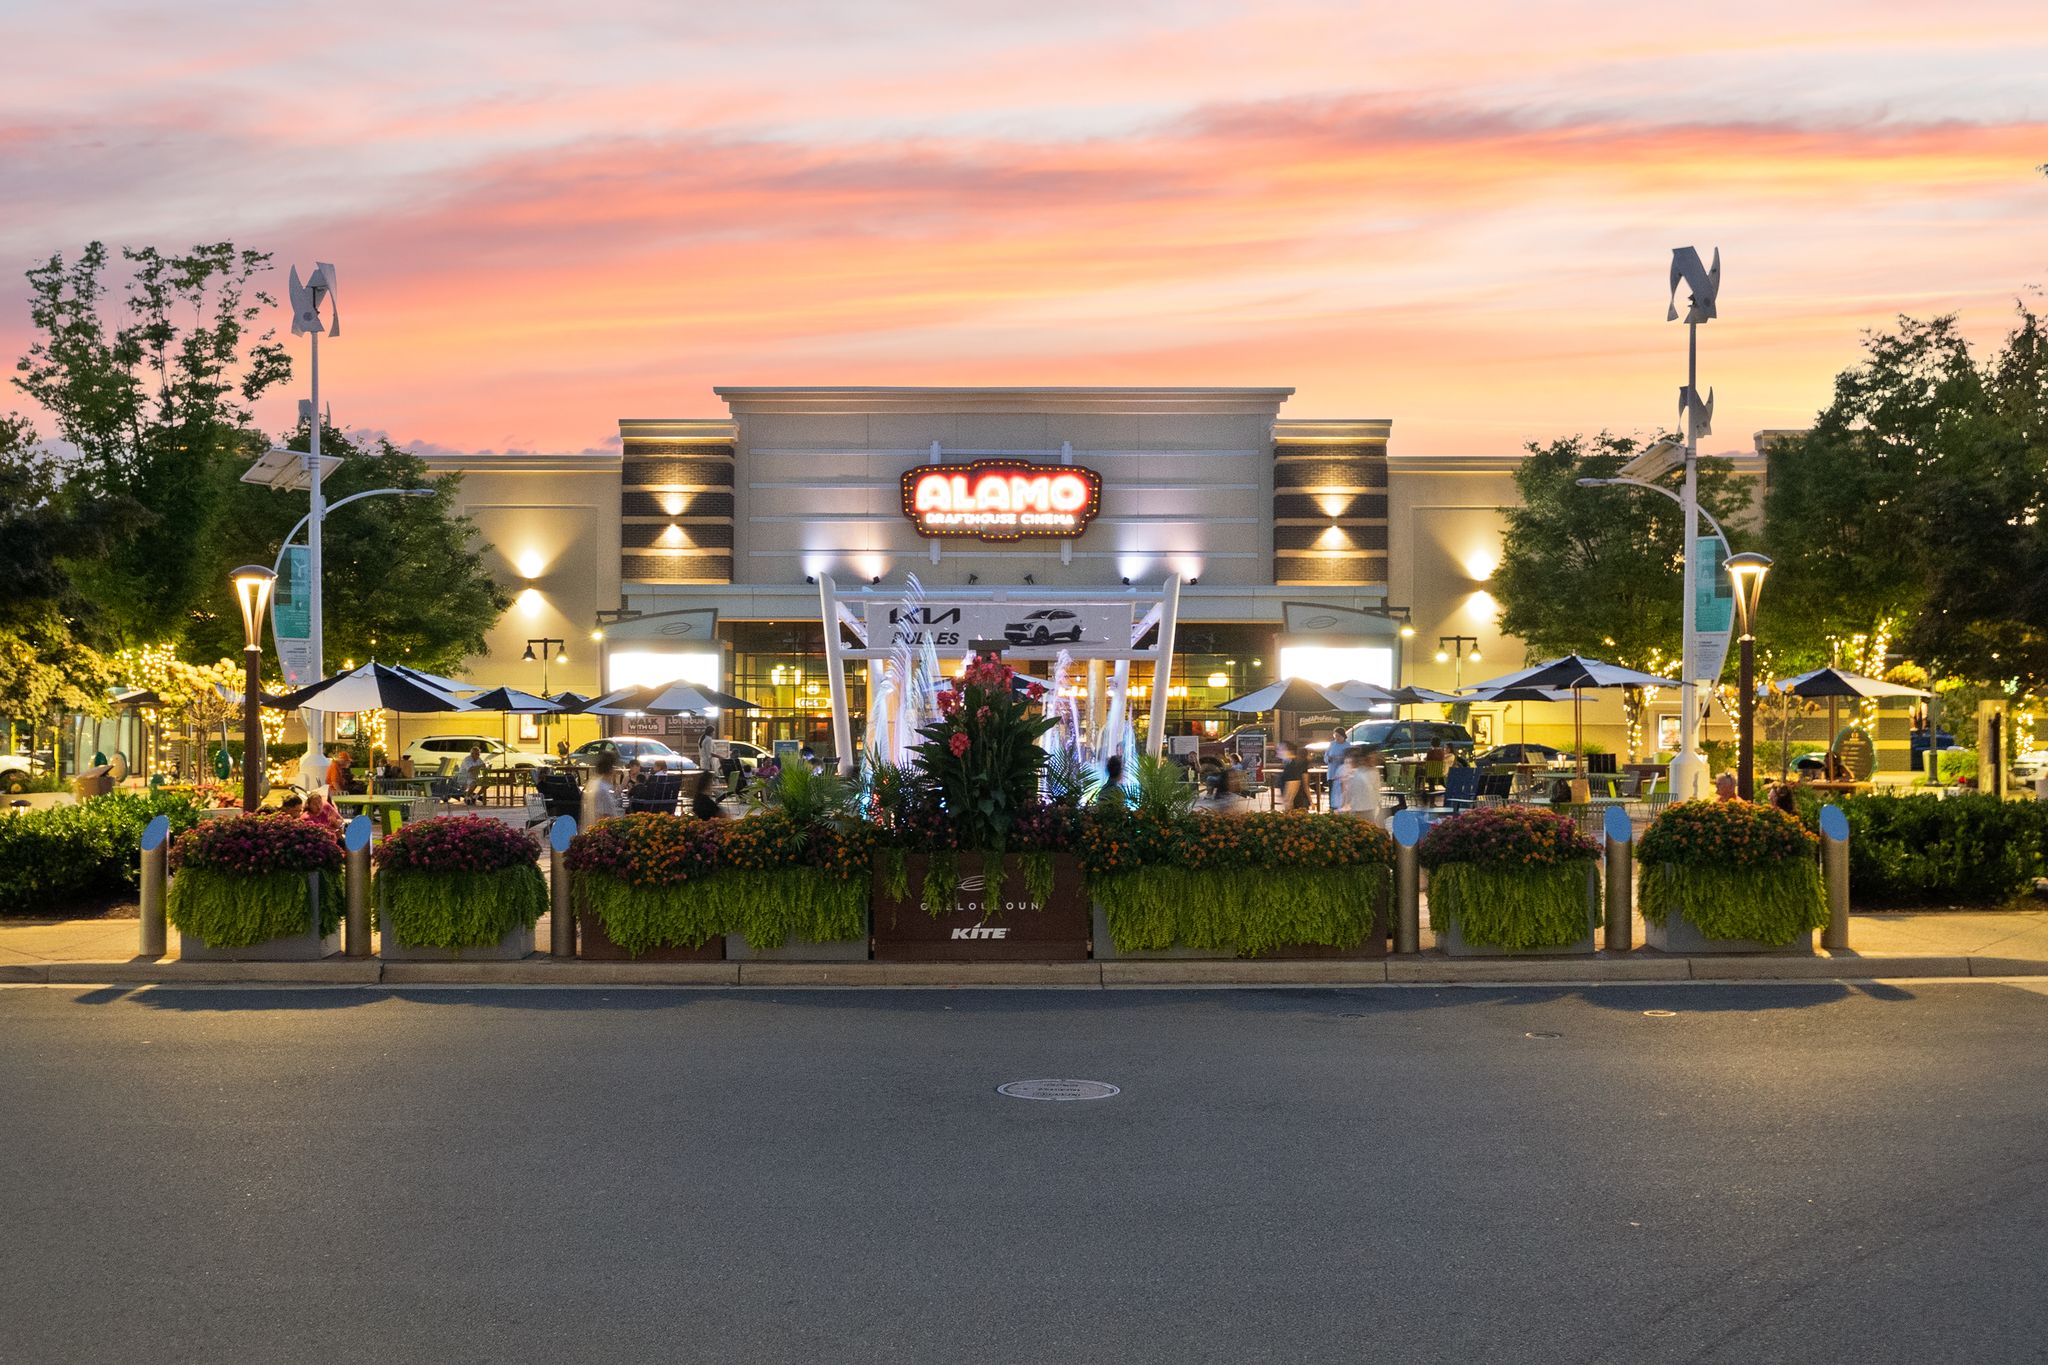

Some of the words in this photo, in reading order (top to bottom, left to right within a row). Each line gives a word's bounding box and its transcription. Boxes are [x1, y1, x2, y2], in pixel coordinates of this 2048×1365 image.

[915, 474, 1088, 511] ALAMO
[925, 513, 1017, 525] DRAFTHOUSE
[1020, 514, 1075, 525] CINEMA
[889, 607, 961, 625] KIA
[891, 631, 960, 645] DULES
[951, 922, 1008, 940] KITE
